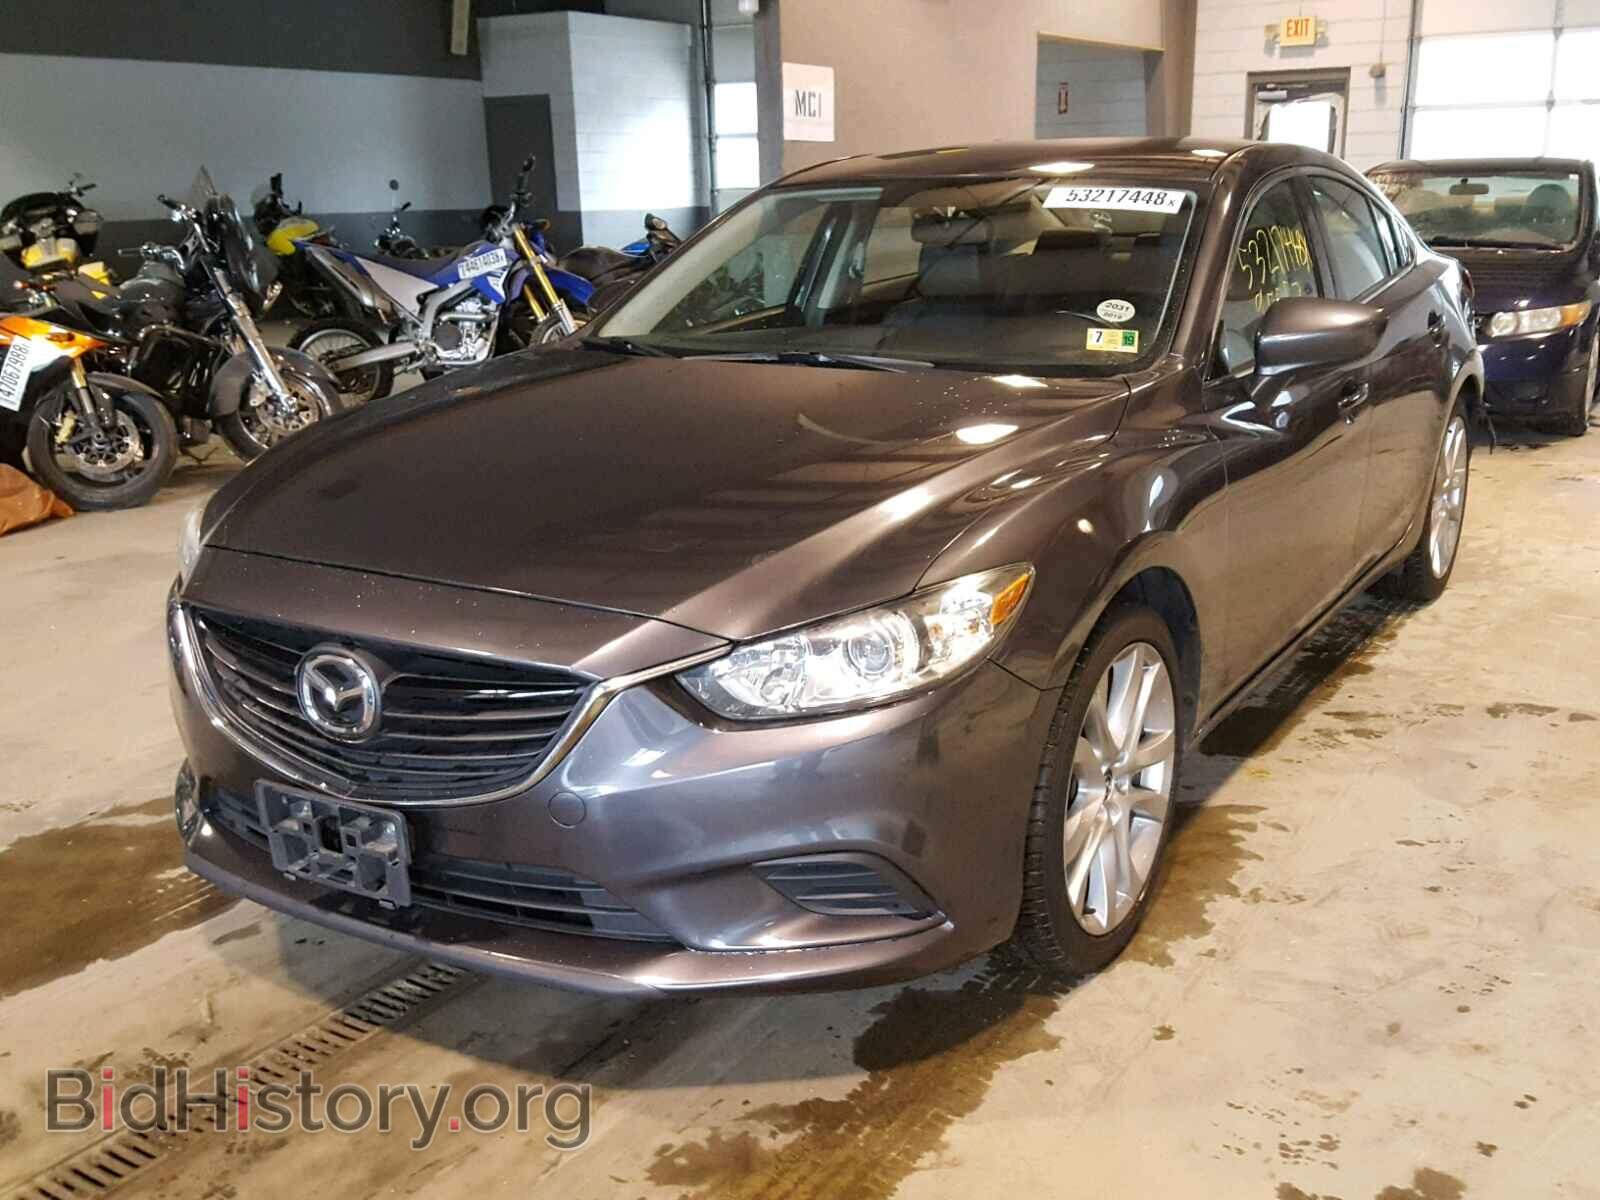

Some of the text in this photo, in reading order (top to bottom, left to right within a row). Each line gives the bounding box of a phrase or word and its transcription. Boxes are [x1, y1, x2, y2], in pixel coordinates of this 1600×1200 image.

[1286, 18, 1310, 37] EXIT
[795, 89, 822, 118] MCI
[1066, 189, 1168, 206] 53217448
[1095, 330, 1103, 343] 7
[1124, 335, 1135, 346] 19
